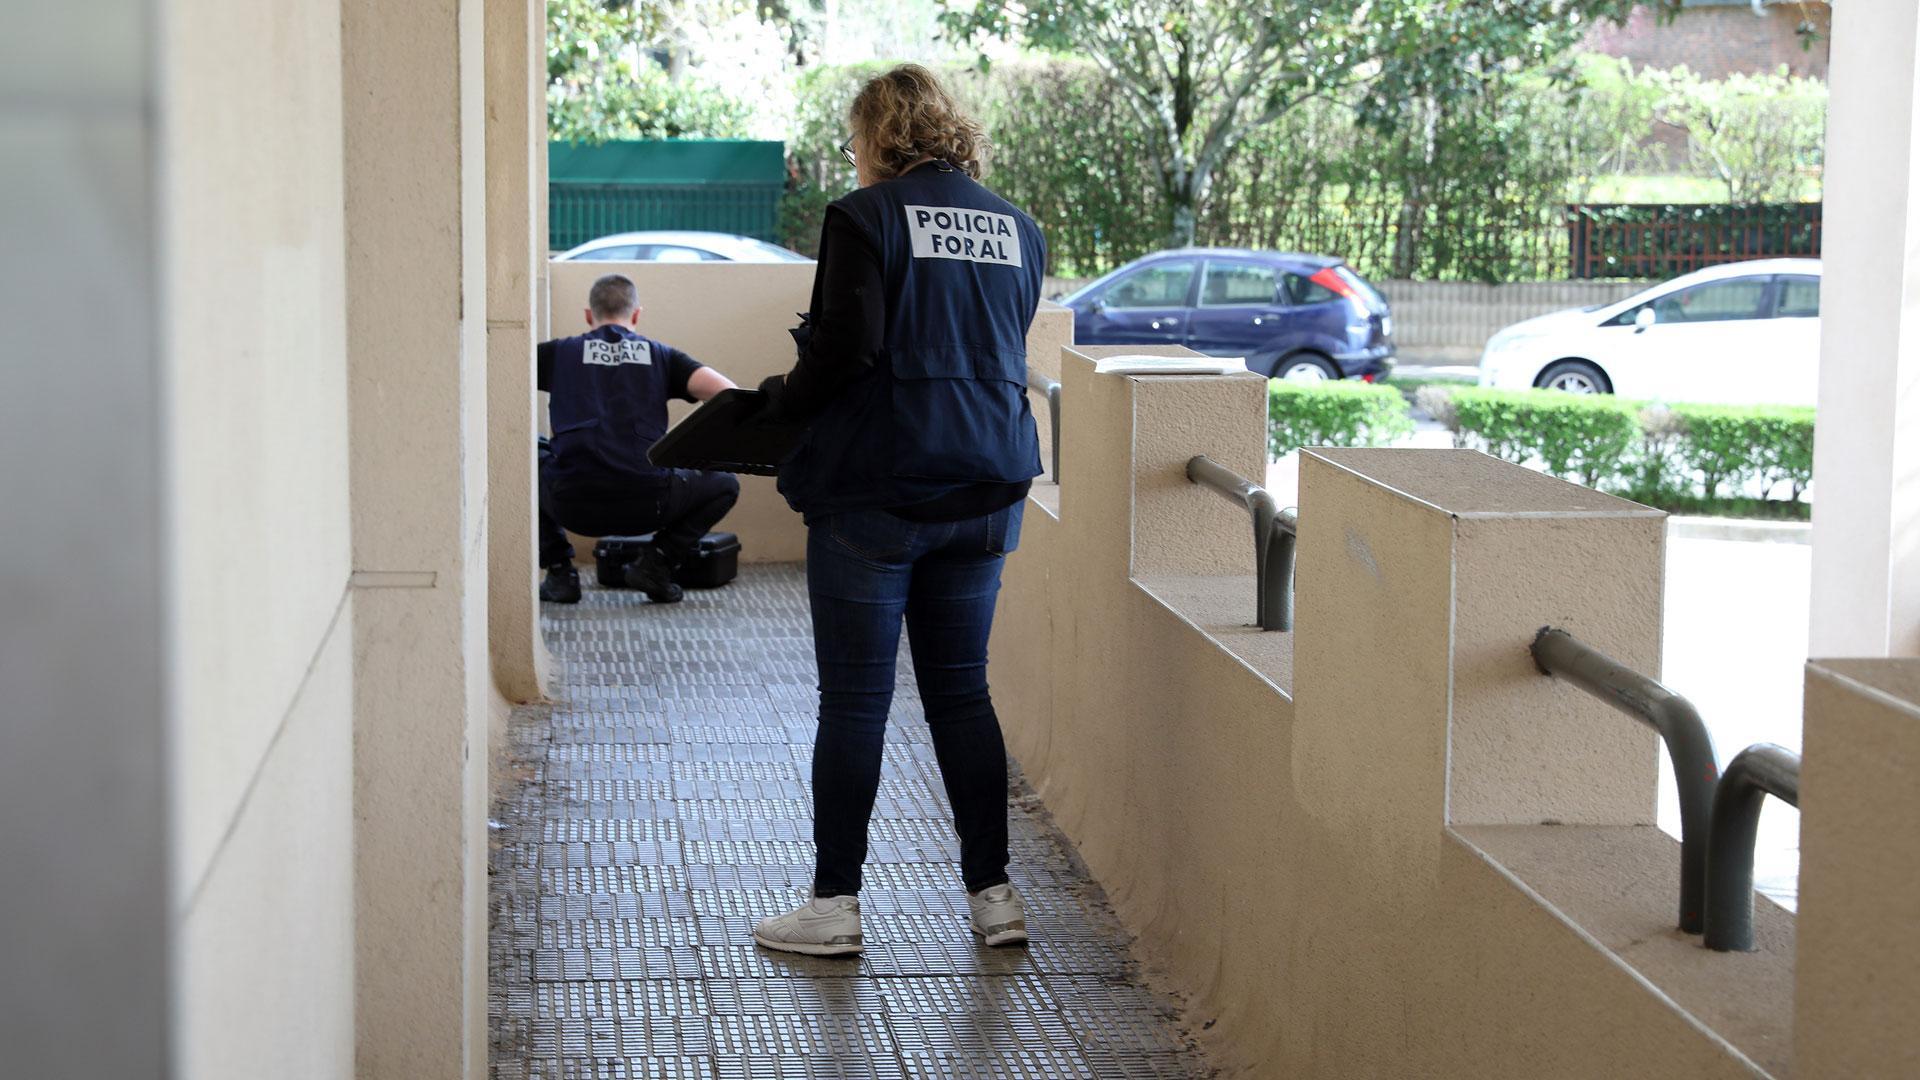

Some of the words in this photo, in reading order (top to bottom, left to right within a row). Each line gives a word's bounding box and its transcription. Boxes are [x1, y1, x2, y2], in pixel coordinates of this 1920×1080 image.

[916, 210, 1012, 237] POLICIA
[931, 234, 1008, 261] FORAL
[589, 341, 646, 353] POLICIA
[592, 351, 639, 363] FORAL
